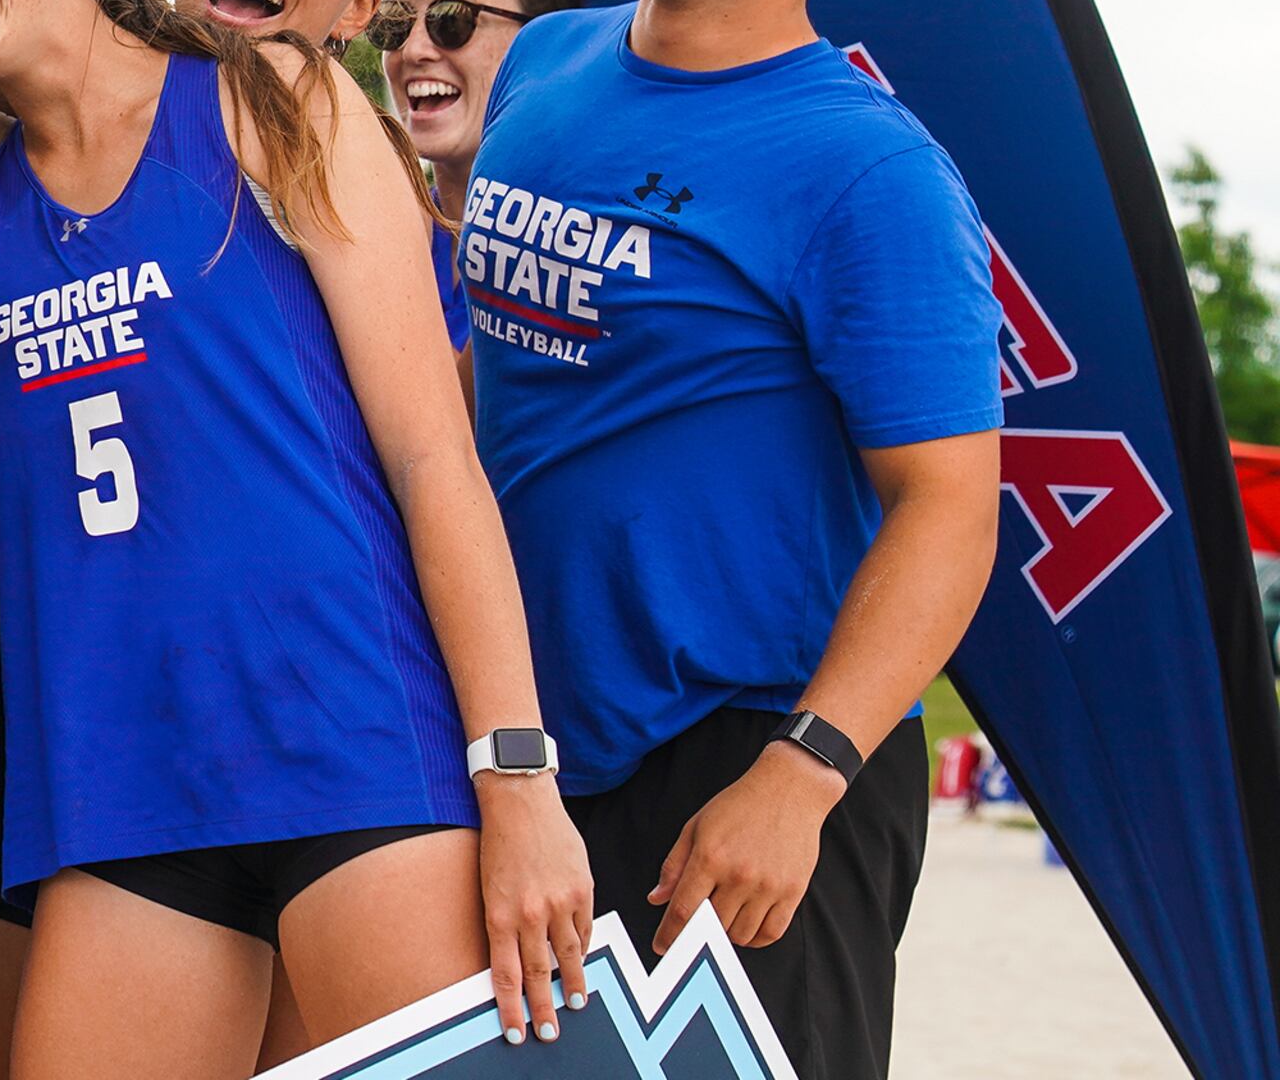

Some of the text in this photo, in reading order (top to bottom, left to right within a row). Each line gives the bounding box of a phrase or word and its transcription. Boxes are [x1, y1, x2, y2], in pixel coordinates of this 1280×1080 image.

[464, 176, 652, 280] GEORGIA
[464, 231, 604, 322] STATE
[14, 308, 145, 380] STATE
[471, 304, 590, 367] VOLLEYBALL
[68, 391, 140, 537] 5
